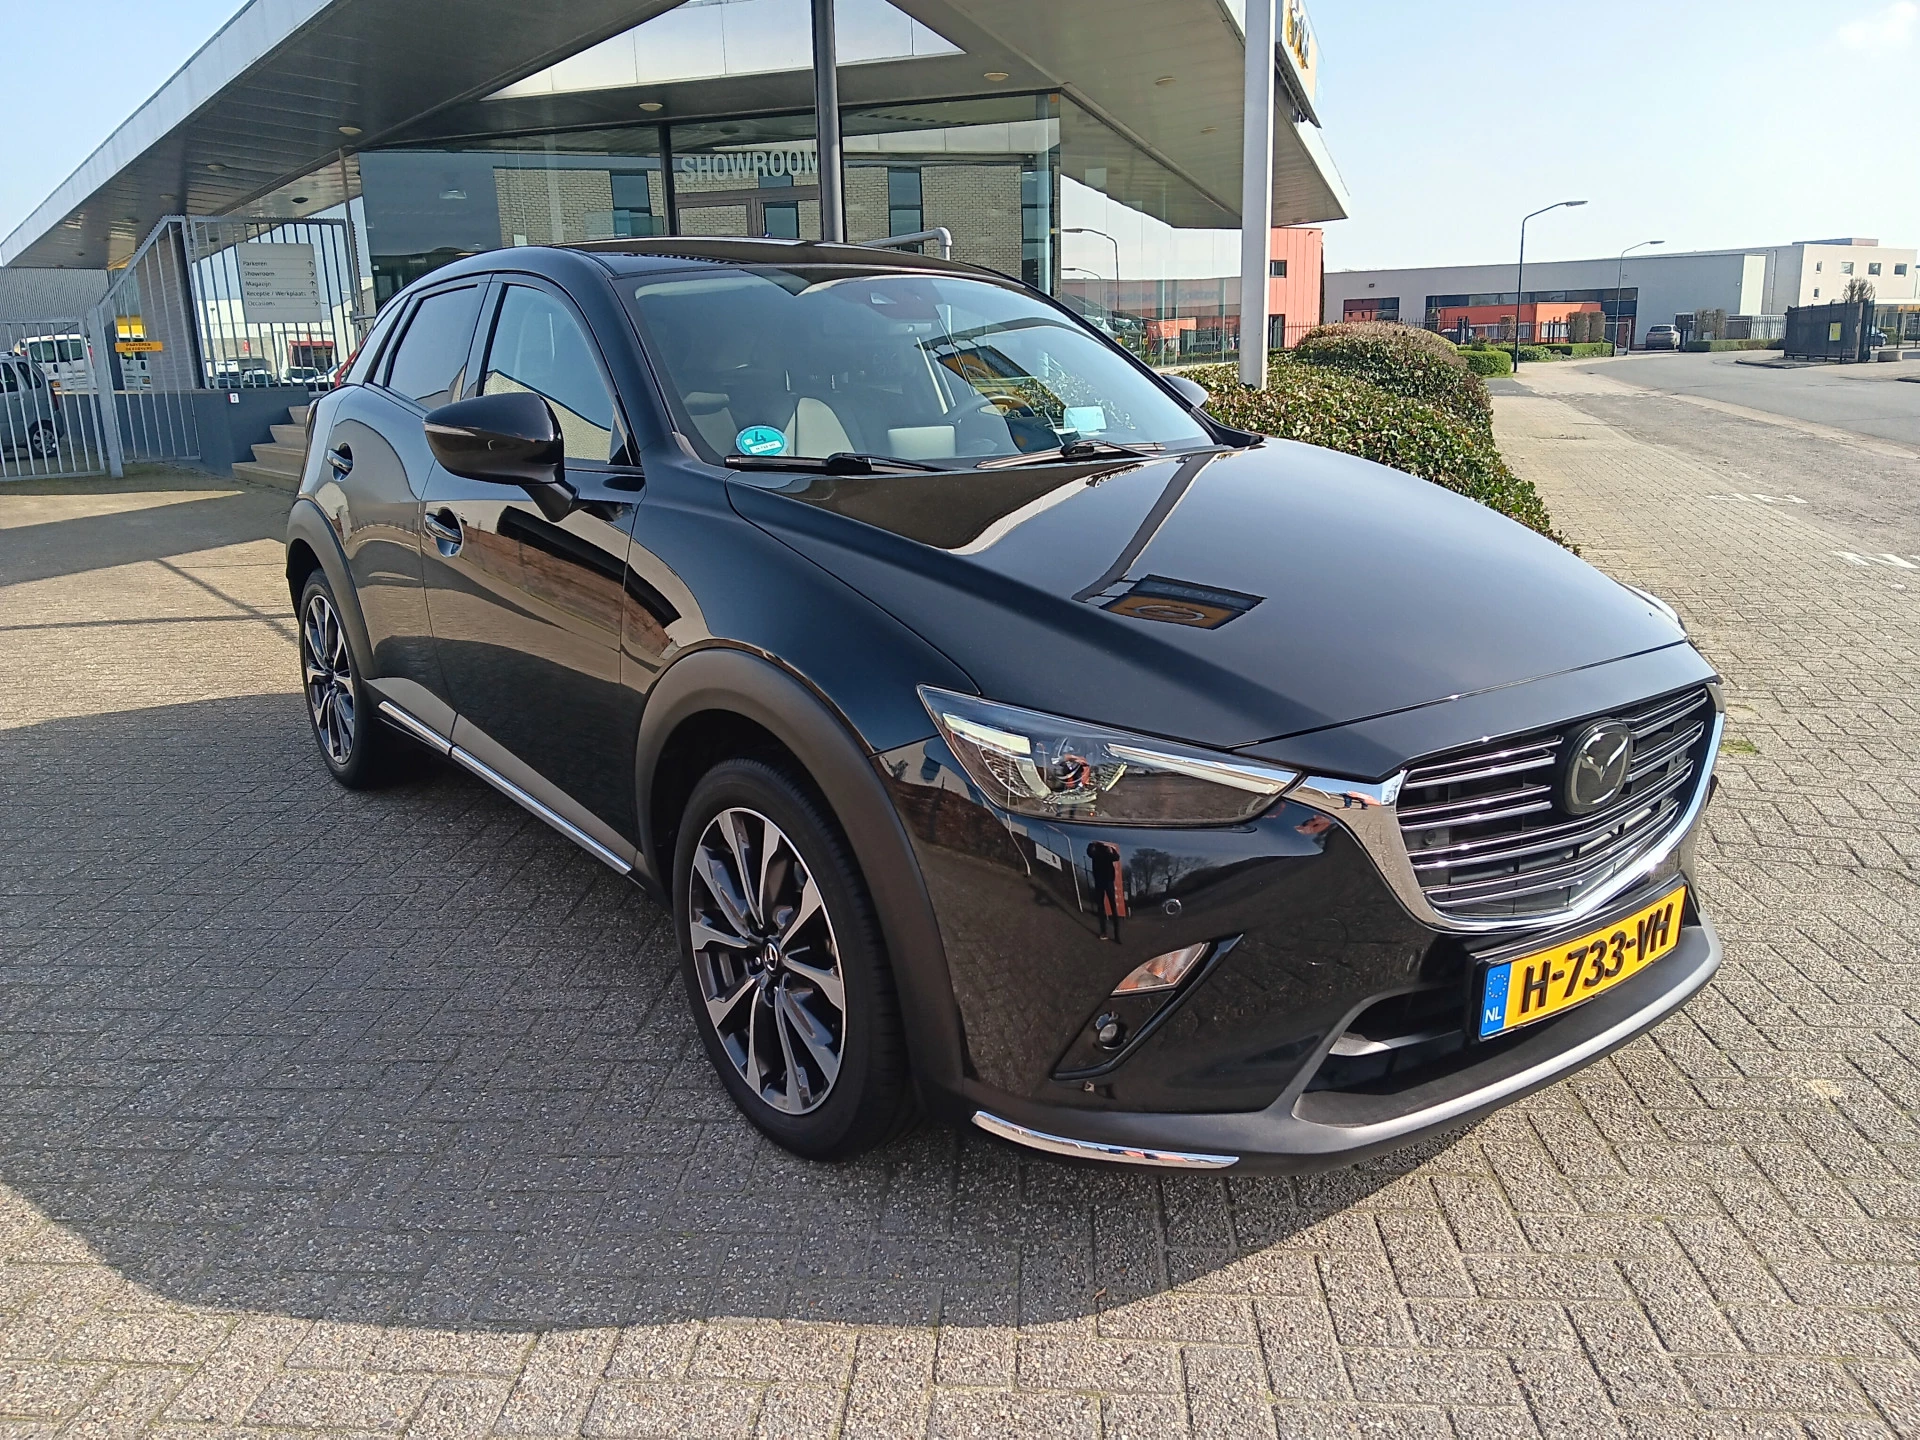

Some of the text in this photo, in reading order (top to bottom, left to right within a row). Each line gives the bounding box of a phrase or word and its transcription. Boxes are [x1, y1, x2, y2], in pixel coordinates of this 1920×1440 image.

[755, 430, 766, 442] 4
[1520, 901, 1674, 1014] H-733-VH
[1484, 1006, 1502, 1024] NL
